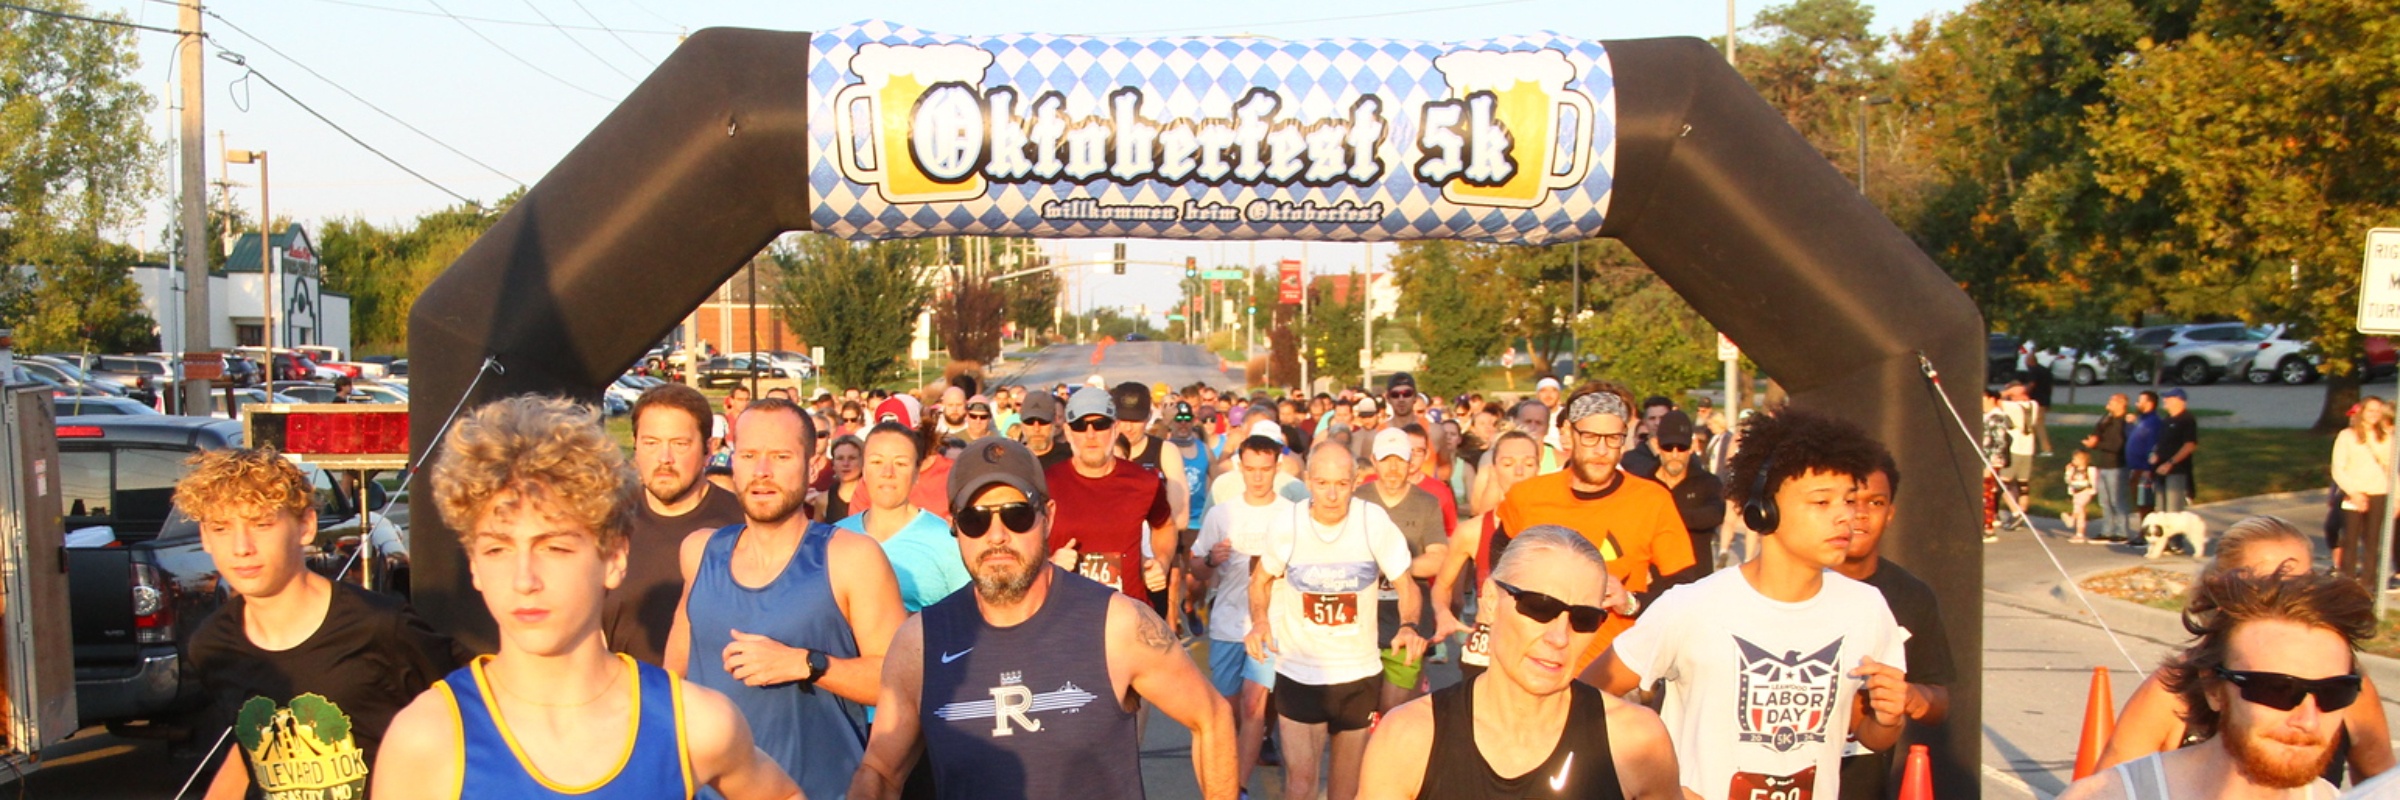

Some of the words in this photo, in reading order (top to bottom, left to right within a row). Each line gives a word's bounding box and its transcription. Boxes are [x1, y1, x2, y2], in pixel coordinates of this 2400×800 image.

[909, 83, 1385, 184] Oktoberfest
[1417, 91, 1516, 184] 5k
[1043, 199, 1178, 219] willkommen
[1246, 199, 1383, 221] Oktoberfest
[2375, 244, 2400, 259] RIG
[1079, 562, 1110, 583] 546
[1314, 603, 1347, 624] 514
[1470, 632, 1490, 653] 58
[1752, 691, 1824, 707] LABOR
[1767, 708, 1806, 724] DAY
[1777, 733, 1793, 745] 5K
[331, 749, 368, 780] 10K
